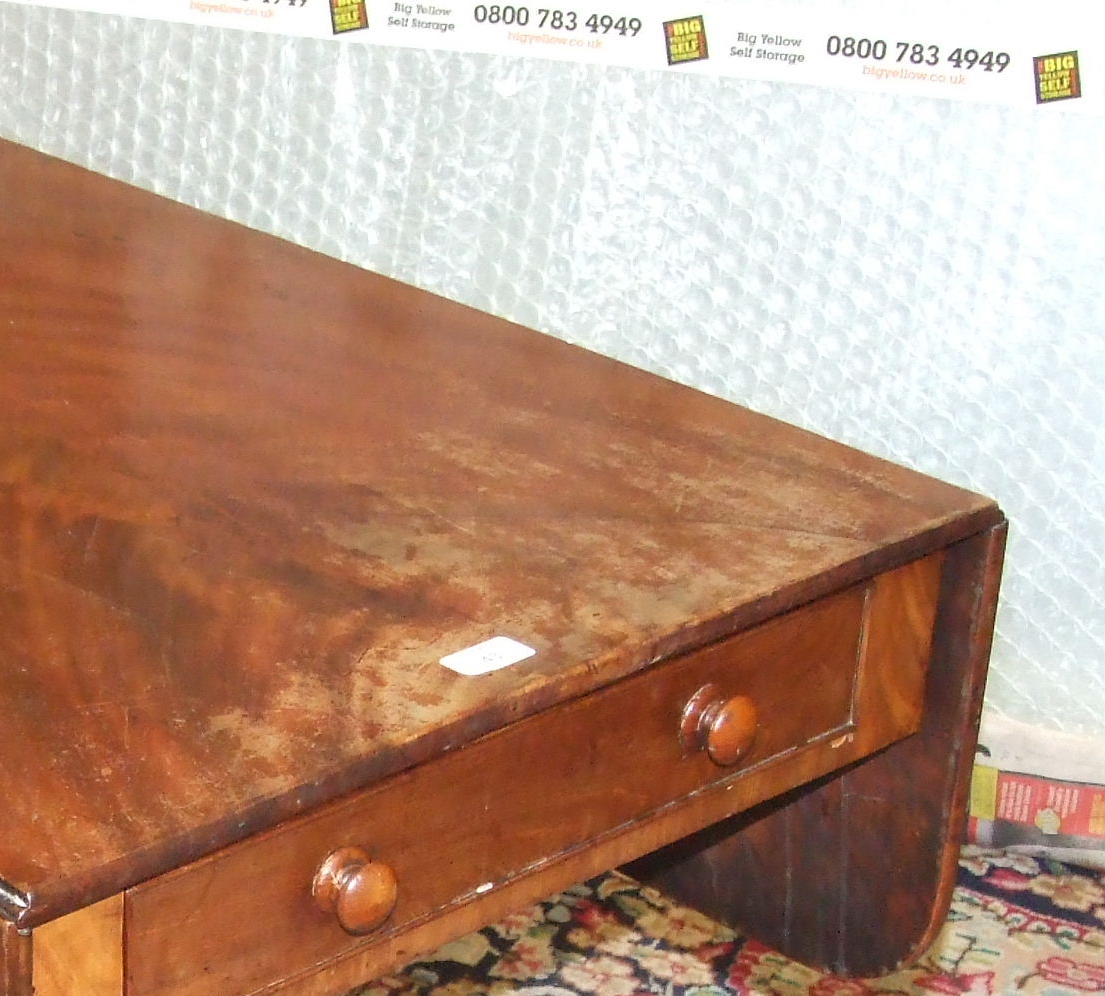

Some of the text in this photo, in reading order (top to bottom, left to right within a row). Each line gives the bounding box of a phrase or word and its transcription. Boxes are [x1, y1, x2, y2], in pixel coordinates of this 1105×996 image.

[394, 2, 452, 17] Big Yellow
[387, 16, 456, 33] Self Storage
[473, 5, 643, 37] 0800 783 4949
[673, 20, 701, 36] BIG
[737, 32, 802, 47] Big Yellow
[729, 46, 806, 64] Self Storage
[826, 35, 1011, 73] 0800 783 4949
[1044, 55, 1075, 73] BIG
[862, 65, 966, 85] bigyellow.co.uk
